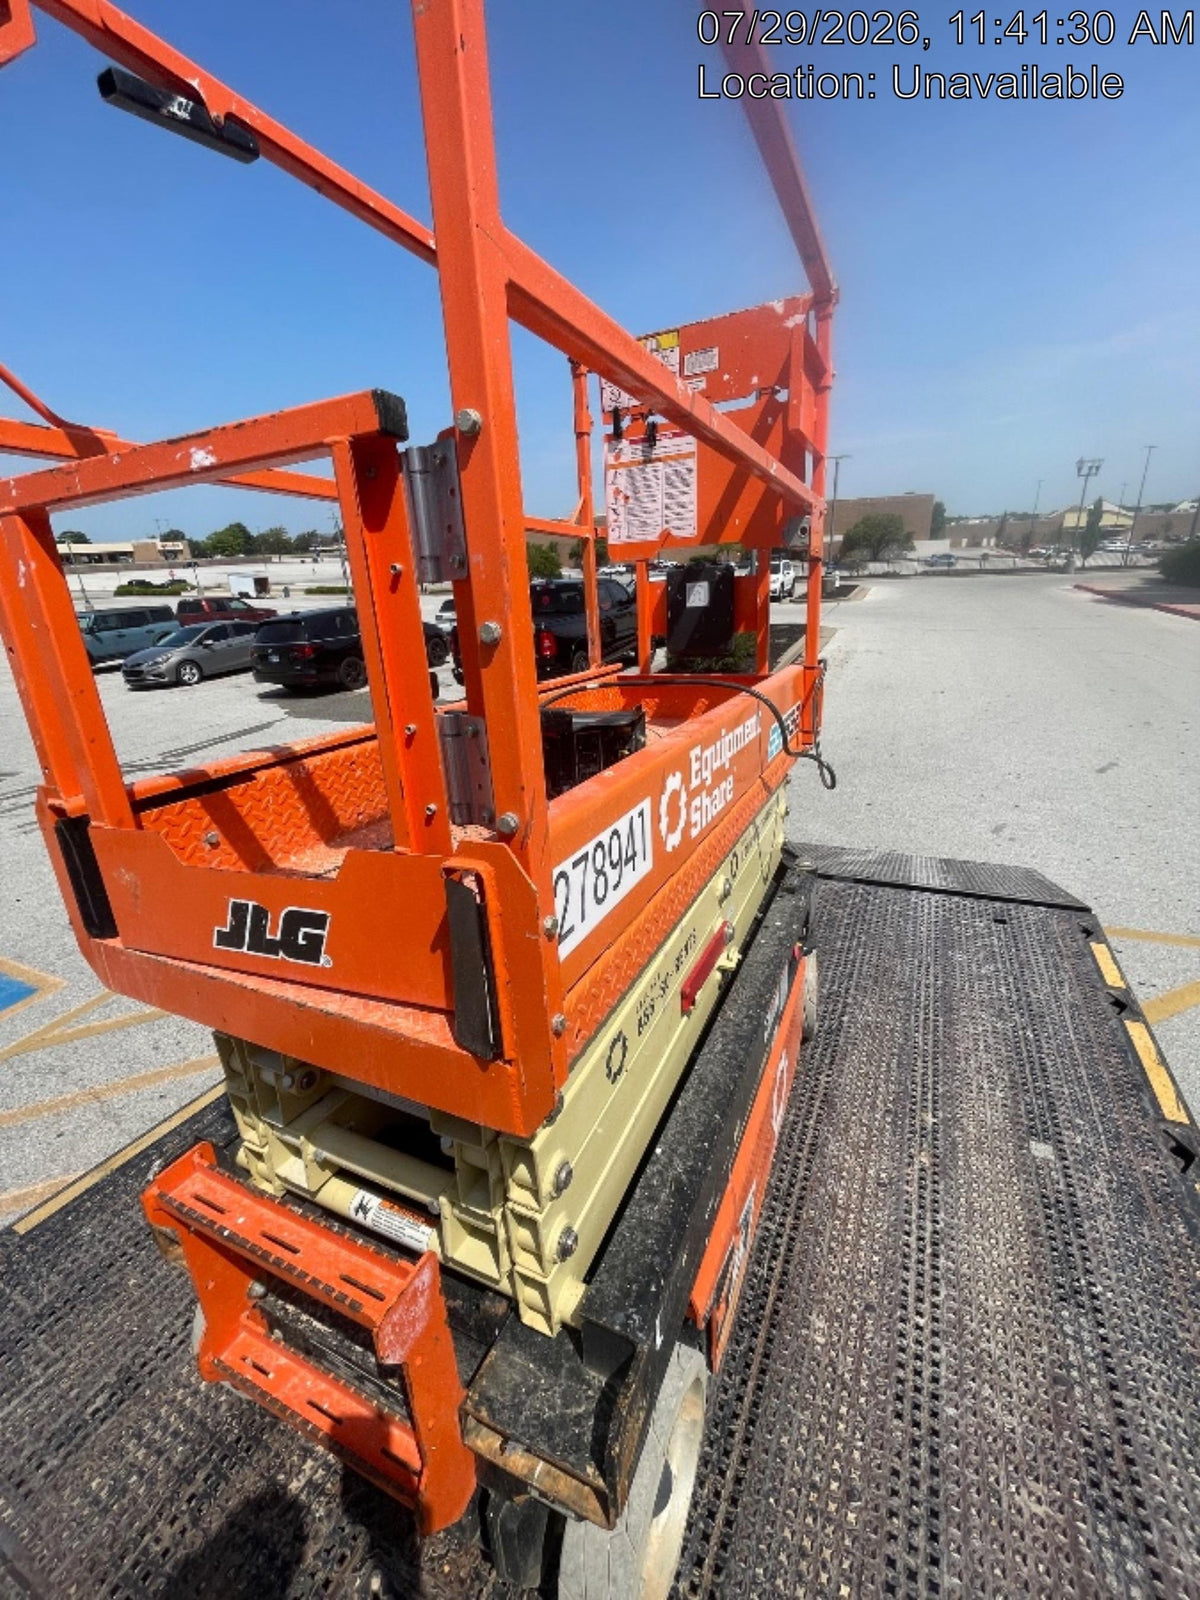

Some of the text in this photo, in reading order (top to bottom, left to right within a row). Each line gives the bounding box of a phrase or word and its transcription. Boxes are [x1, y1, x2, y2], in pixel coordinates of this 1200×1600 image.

[690, 773, 733, 839] Share
[554, 808, 646, 946] 278941
[213, 898, 331, 967] JLG
